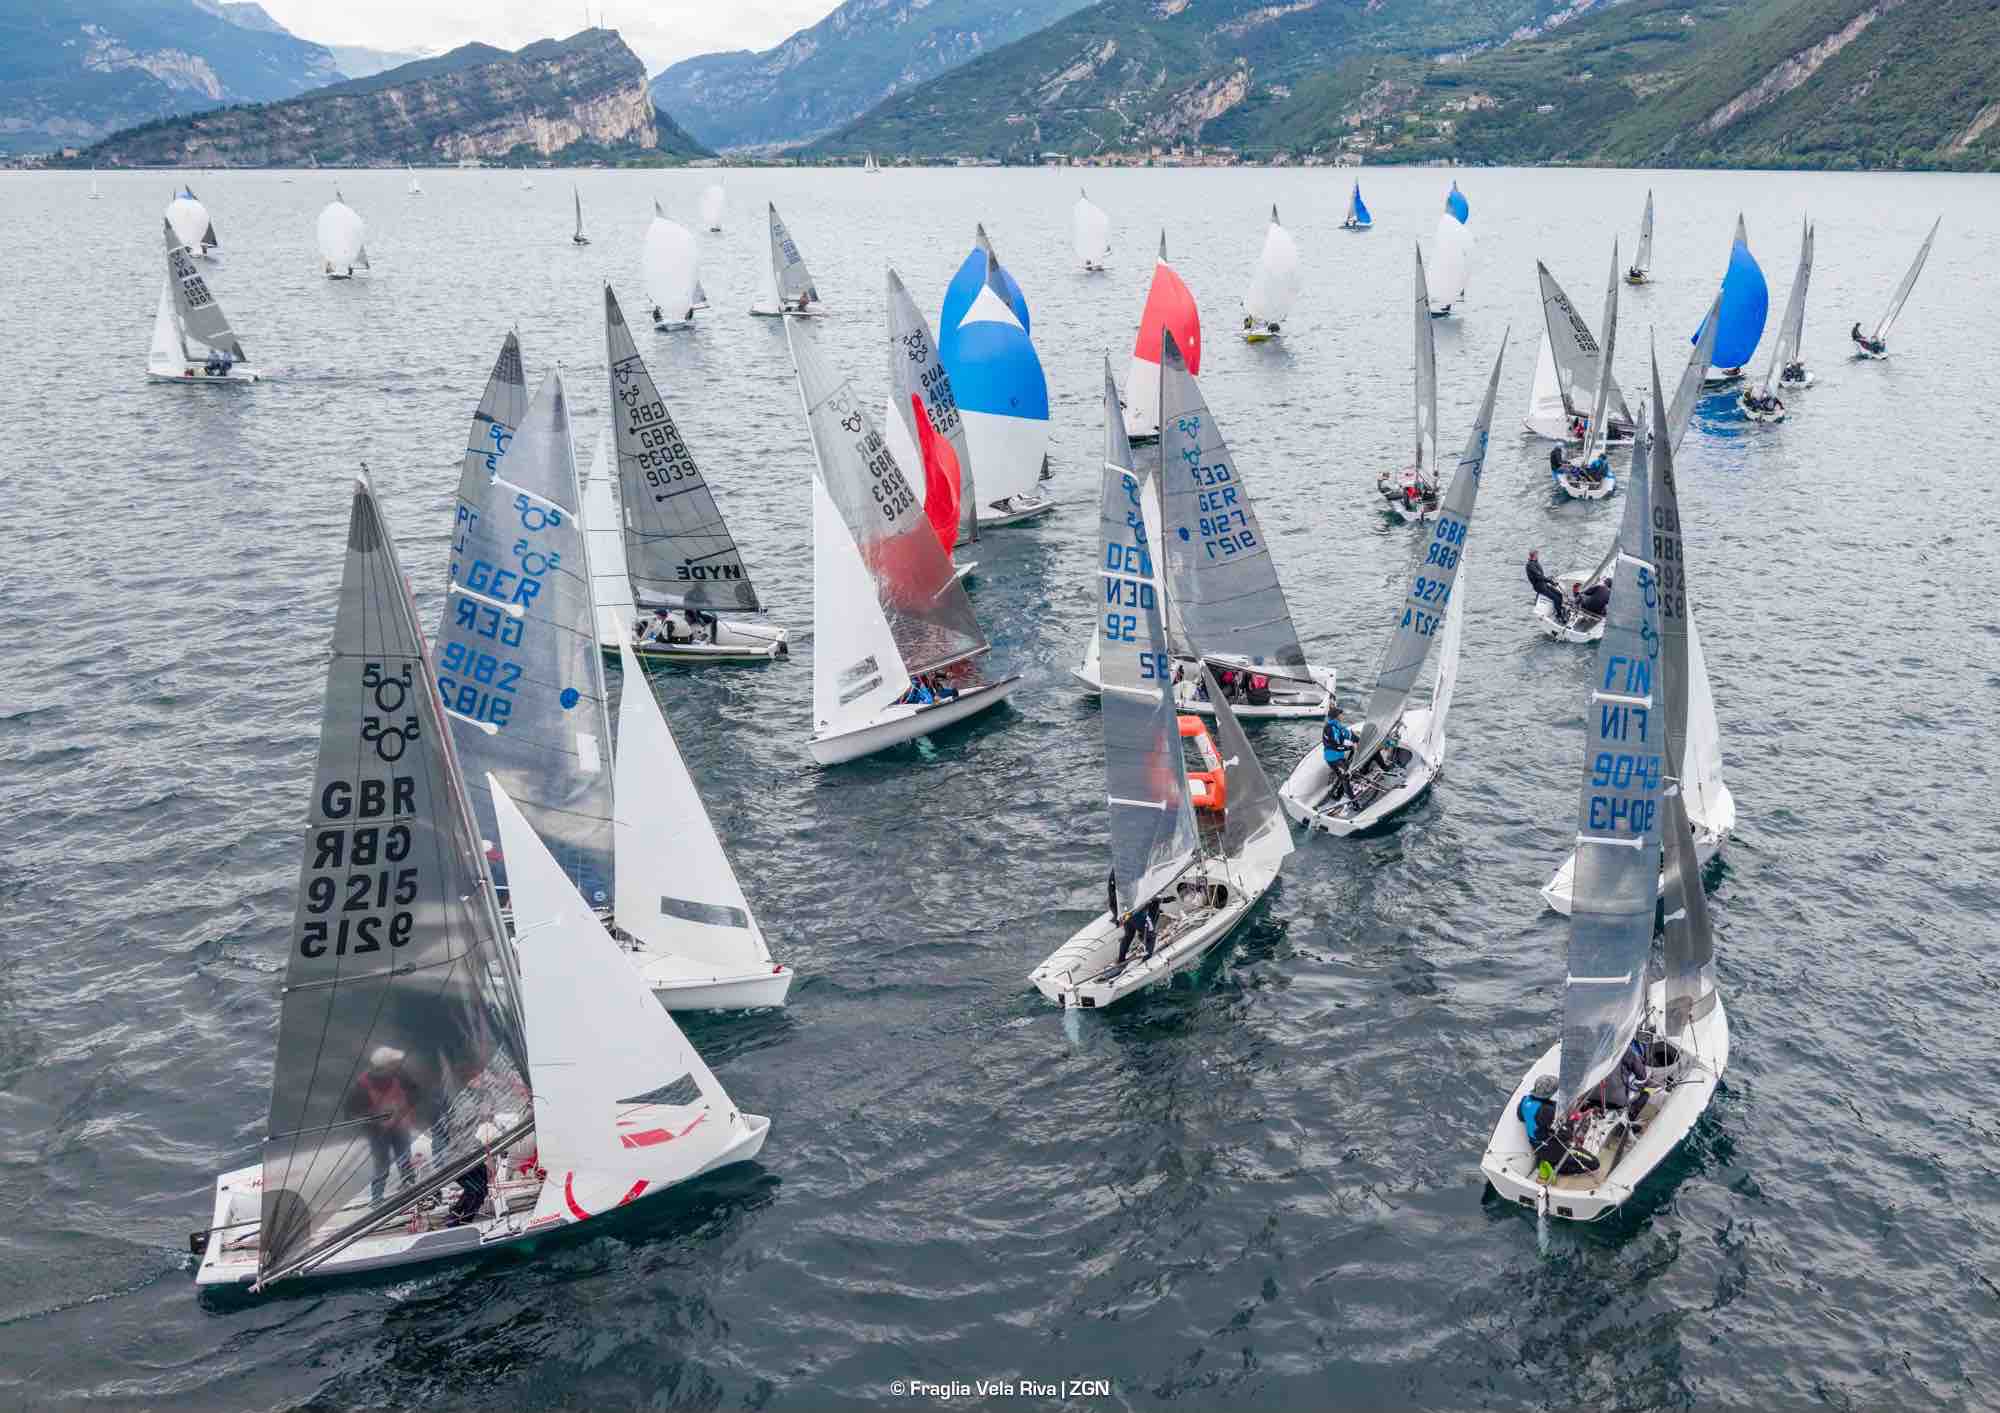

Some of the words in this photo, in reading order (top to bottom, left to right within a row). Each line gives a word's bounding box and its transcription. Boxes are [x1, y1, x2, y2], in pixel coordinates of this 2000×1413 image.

[929, 376, 951, 403] AUS
[641, 424, 677, 448] GBR
[646, 461, 696, 487] 9039
[869, 447, 895, 478] GBR
[513, 493, 561, 532] 505
[1199, 487, 1238, 512] GER
[1437, 517, 1467, 546] GBR
[466, 560, 541, 608] GER
[1107, 613, 1137, 642] 92
[441, 641, 522, 693] 9182
[1604, 655, 1649, 695] FIN
[362, 663, 412, 712] 505
[1591, 751, 1661, 791] 9043
[322, 776, 416, 819] GBR
[307, 868, 418, 914] 9215
